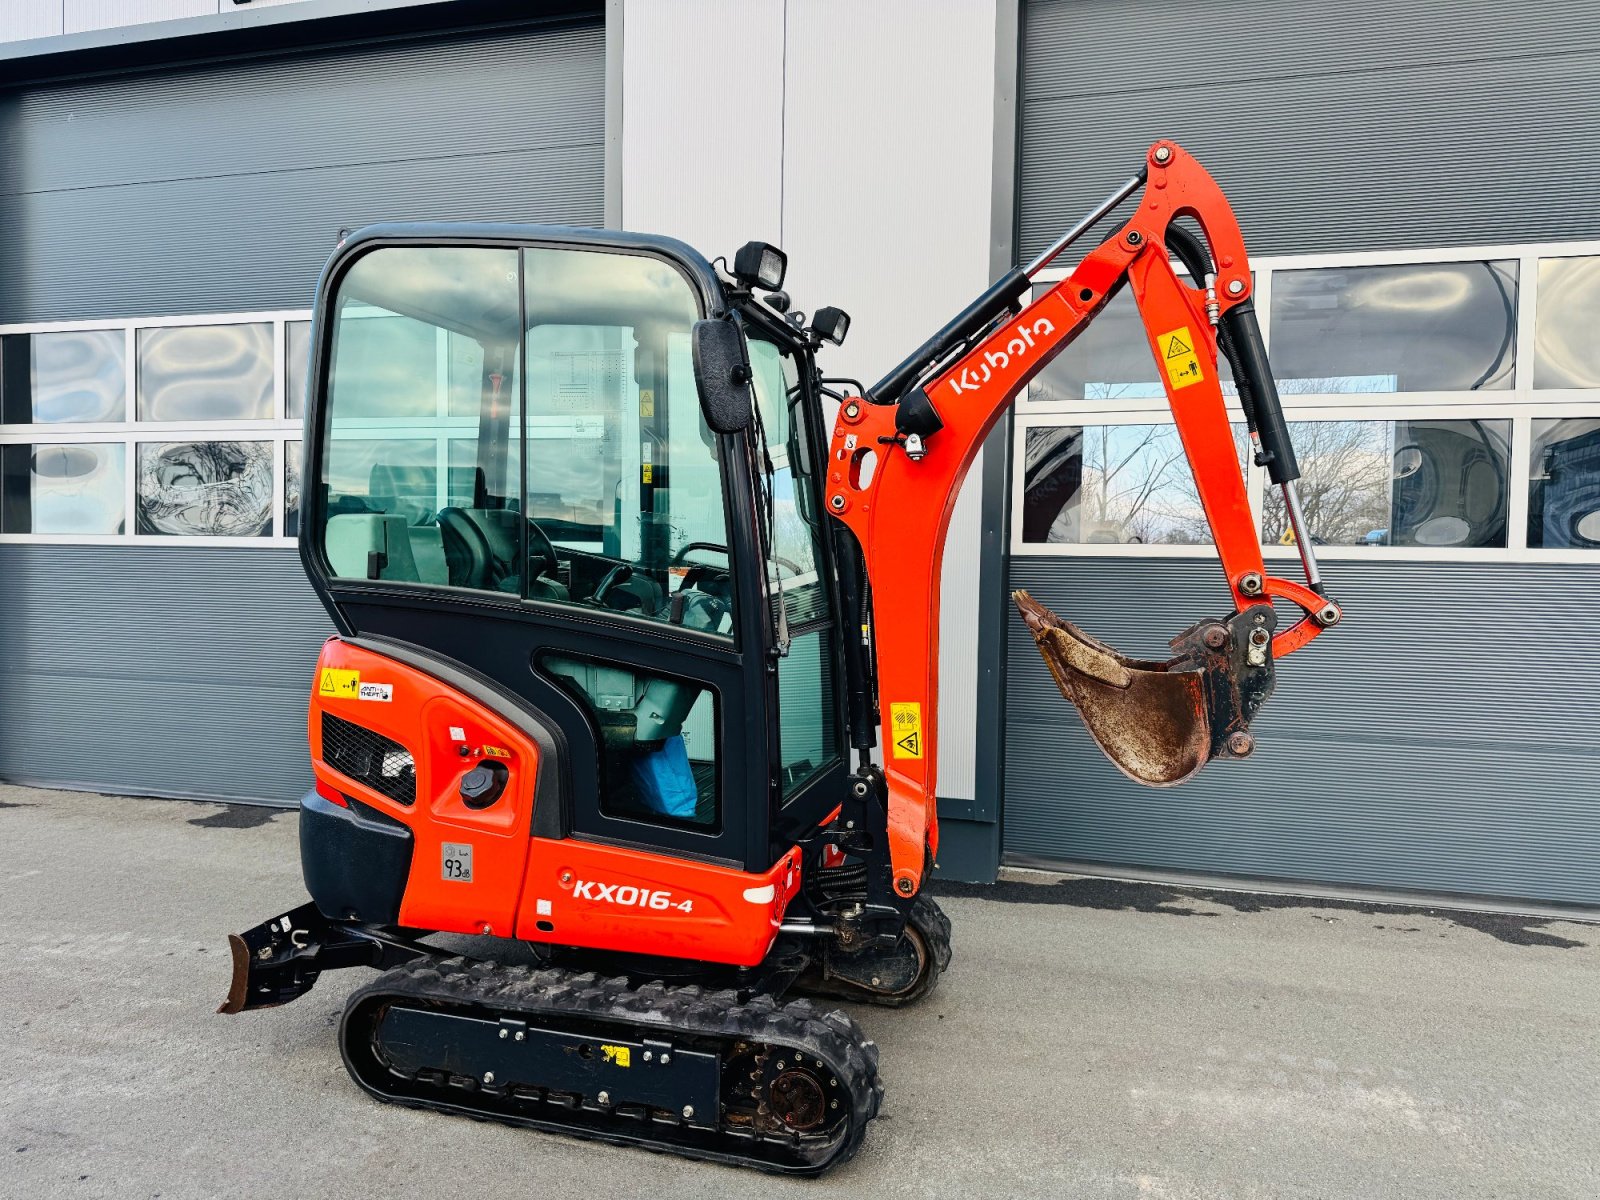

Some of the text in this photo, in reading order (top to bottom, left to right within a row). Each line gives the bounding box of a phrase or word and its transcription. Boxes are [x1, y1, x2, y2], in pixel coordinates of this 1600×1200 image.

[949, 318, 1055, 395] Kubota
[445, 859, 470, 878] 93 dB
[573, 880, 693, 913] KX016-4
